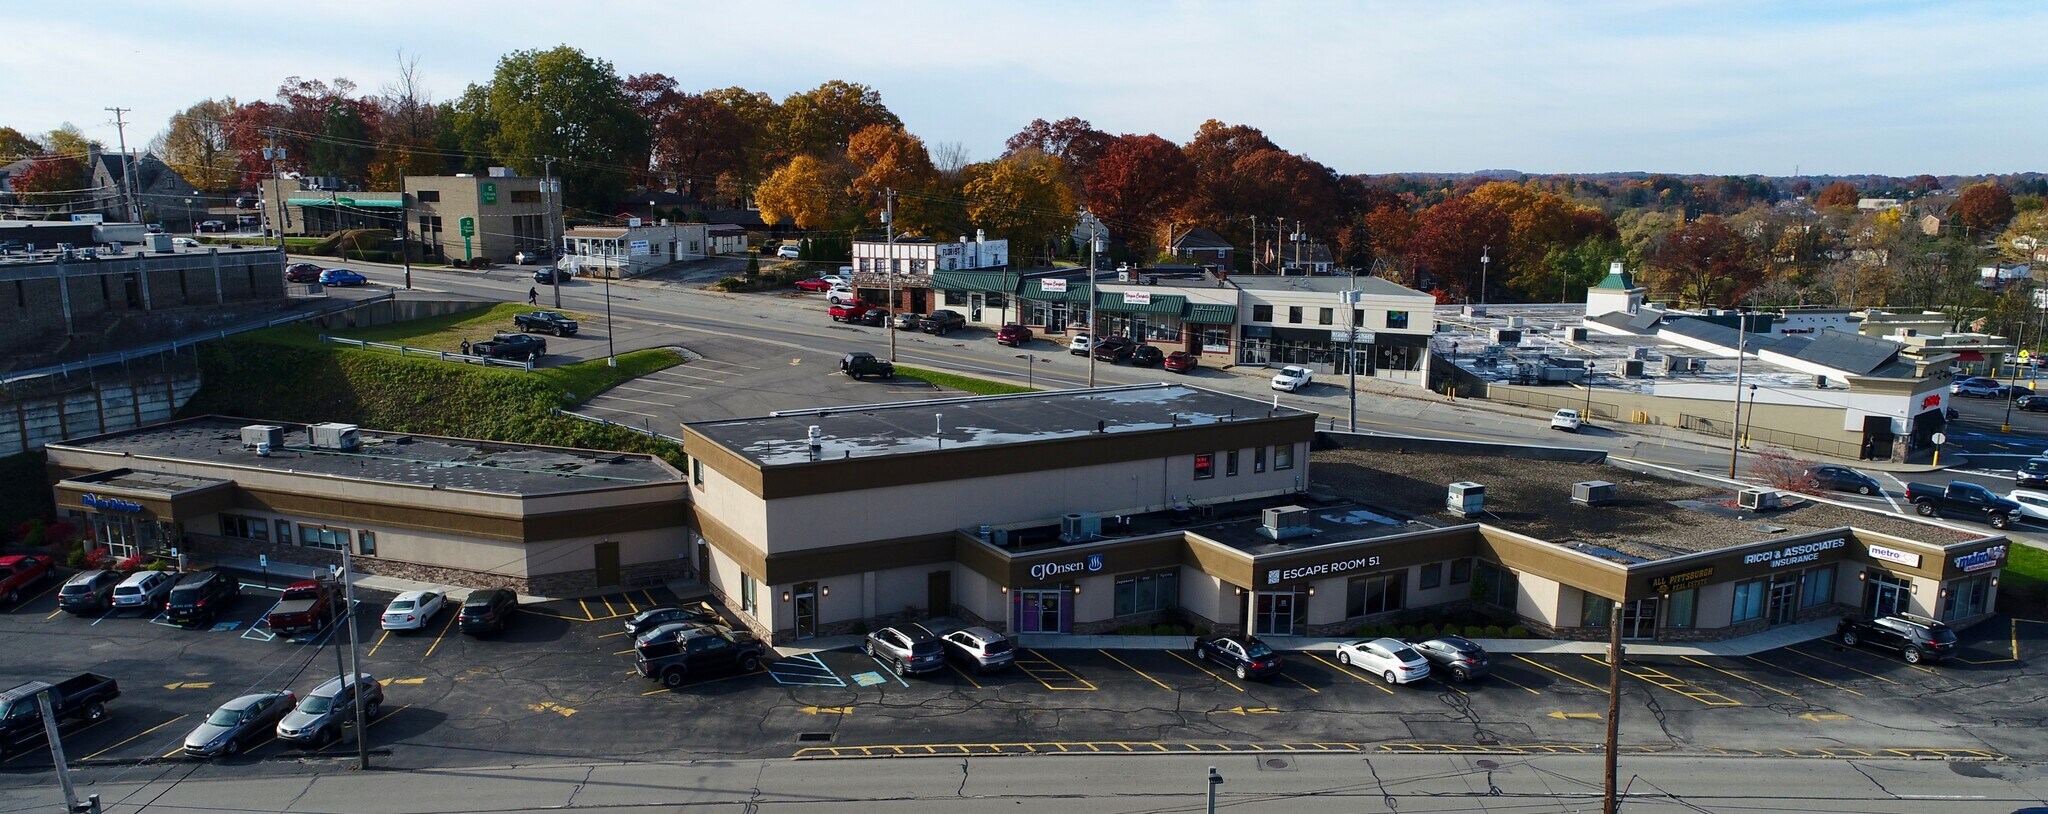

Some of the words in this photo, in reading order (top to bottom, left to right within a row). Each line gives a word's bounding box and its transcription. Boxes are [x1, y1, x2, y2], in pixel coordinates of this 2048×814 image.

[1744, 551, 1773, 564] RICCI
[1773, 550, 1781, 559] &
[1784, 538, 1845, 557] ASSOCIATES
[1769, 552, 1819, 568] INSURANCE
[1031, 562, 1084, 580] CJOnsen
[1283, 564, 1329, 580] ESCAPE
[1331, 558, 1365, 572] ROOM
[1368, 556, 1380, 566] 51
[1653, 577, 1666, 586] ALL
[1669, 567, 1714, 584] PITTSBURGH
[1672, 583, 1686, 591] REAL
[1687, 578, 1709, 590] ESTATE
